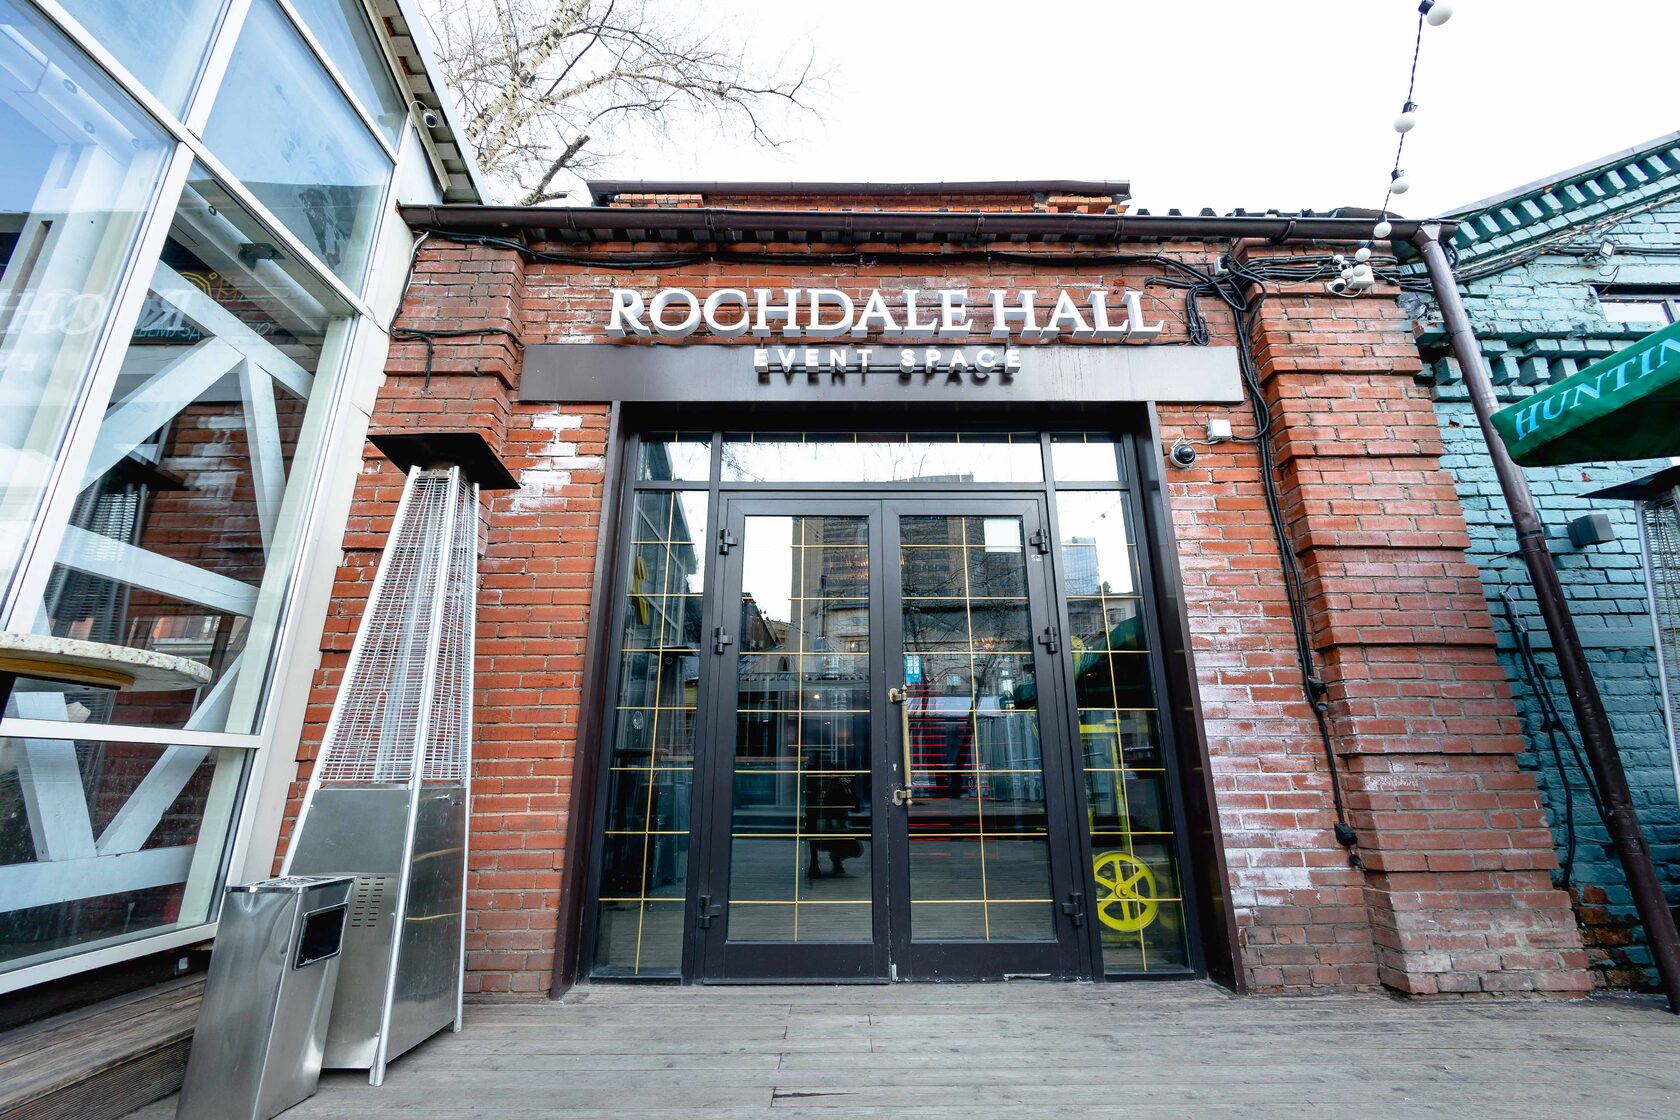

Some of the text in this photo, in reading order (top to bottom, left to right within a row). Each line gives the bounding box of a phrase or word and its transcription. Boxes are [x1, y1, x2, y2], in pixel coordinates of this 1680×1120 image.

[604, 287, 1165, 338] ROCHDALE HALL
[754, 348, 1021, 374] EVENT SPACE
